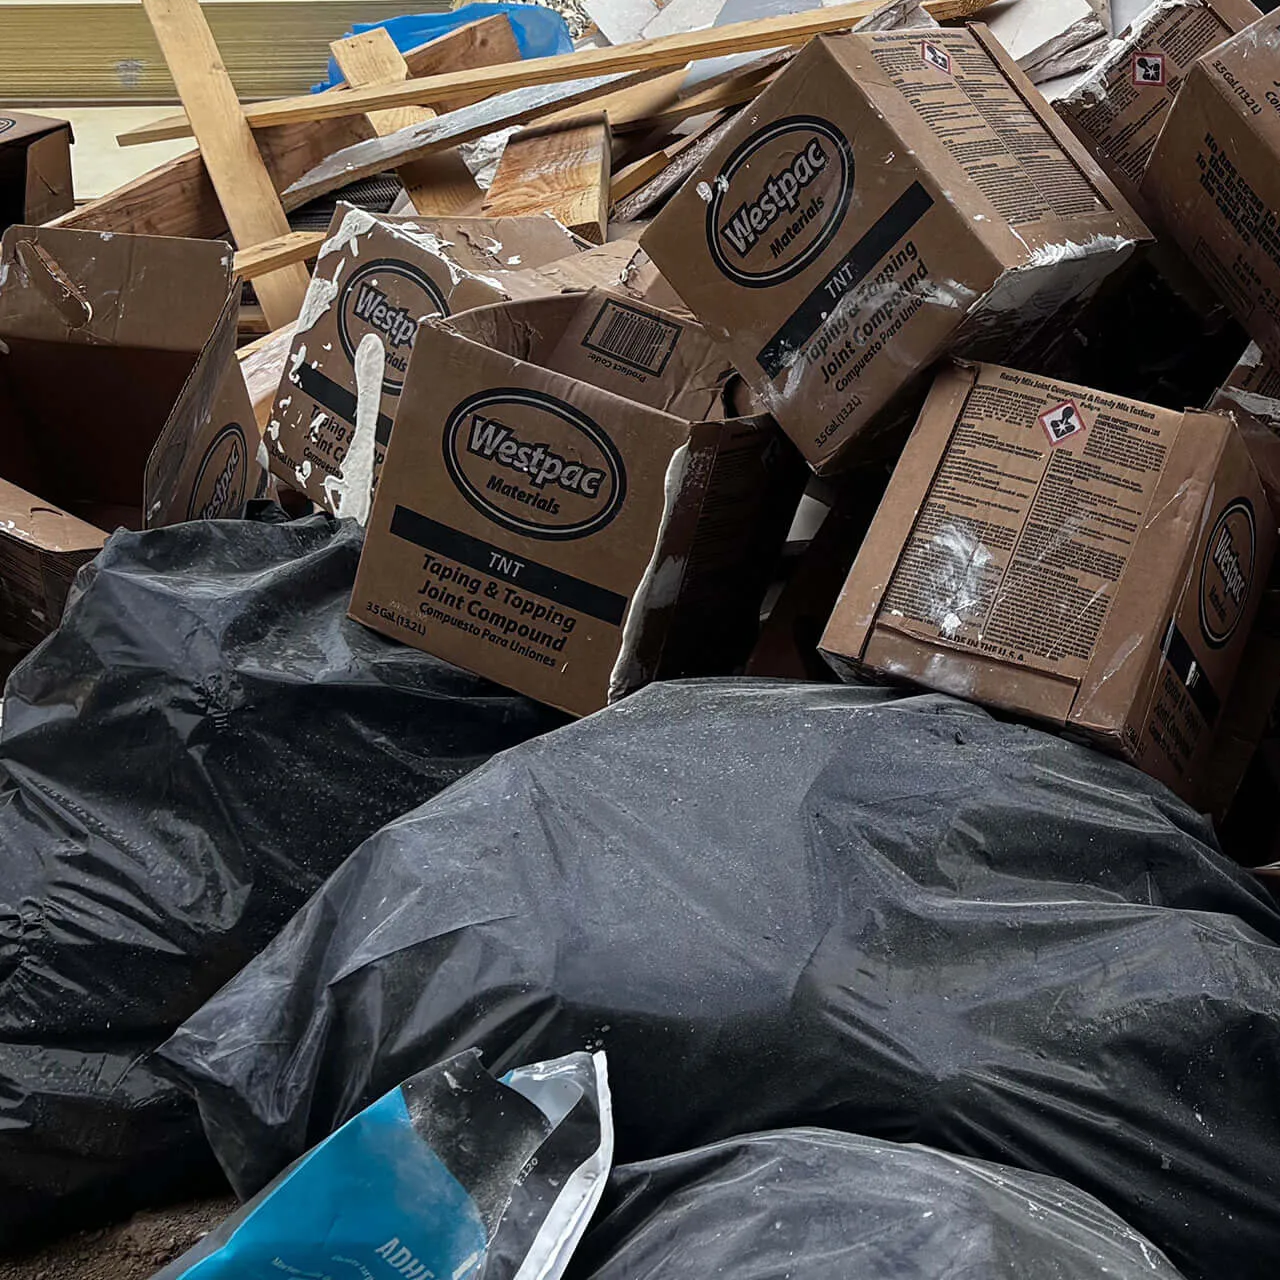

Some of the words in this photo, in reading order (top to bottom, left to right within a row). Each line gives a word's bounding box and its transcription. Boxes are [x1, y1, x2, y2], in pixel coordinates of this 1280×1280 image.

[1222, 70, 1238, 89] Gal.
[723, 140, 828, 255] Westpac
[769, 196, 825, 259] Materials
[824, 262, 855, 299] TNT
[355, 282, 417, 348] Westp
[821, 339, 856, 384] Joint
[852, 259, 929, 345] Compound
[587, 352, 613, 368] Code:
[613, 363, 647, 383] Product
[834, 342, 882, 393] Compuesto
[880, 323, 902, 345] Para
[310, 404, 346, 441] Tping
[1000, 372, 1020, 385] Ready
[1021, 377, 1034, 386] Mix
[1033, 380, 1051, 391] Joint
[1051, 384, 1088, 400] Compound
[1094, 395, 1116, 409] Ready
[1116, 401, 1129, 413] Mix
[1129, 406, 1156, 420] Texture
[469, 416, 603, 496] Westpac
[824, 420, 840, 438] Gal.
[486, 475, 560, 515] Materials
[488, 551, 525, 578] TNT
[1213, 523, 1246, 604] Westpac
[366, 602, 380, 615] 3.5
[380, 607, 396, 623] Gal.
[418, 579, 465, 610] Joint
[467, 600, 568, 652] Compound
[422, 554, 482, 595] Taping
[483, 581, 500, 599] &
[502, 587, 577, 633] Topping
[419, 602, 481, 636] Compuesto
[481, 629, 508, 649] Para
[509, 640, 556, 668] Uniones
